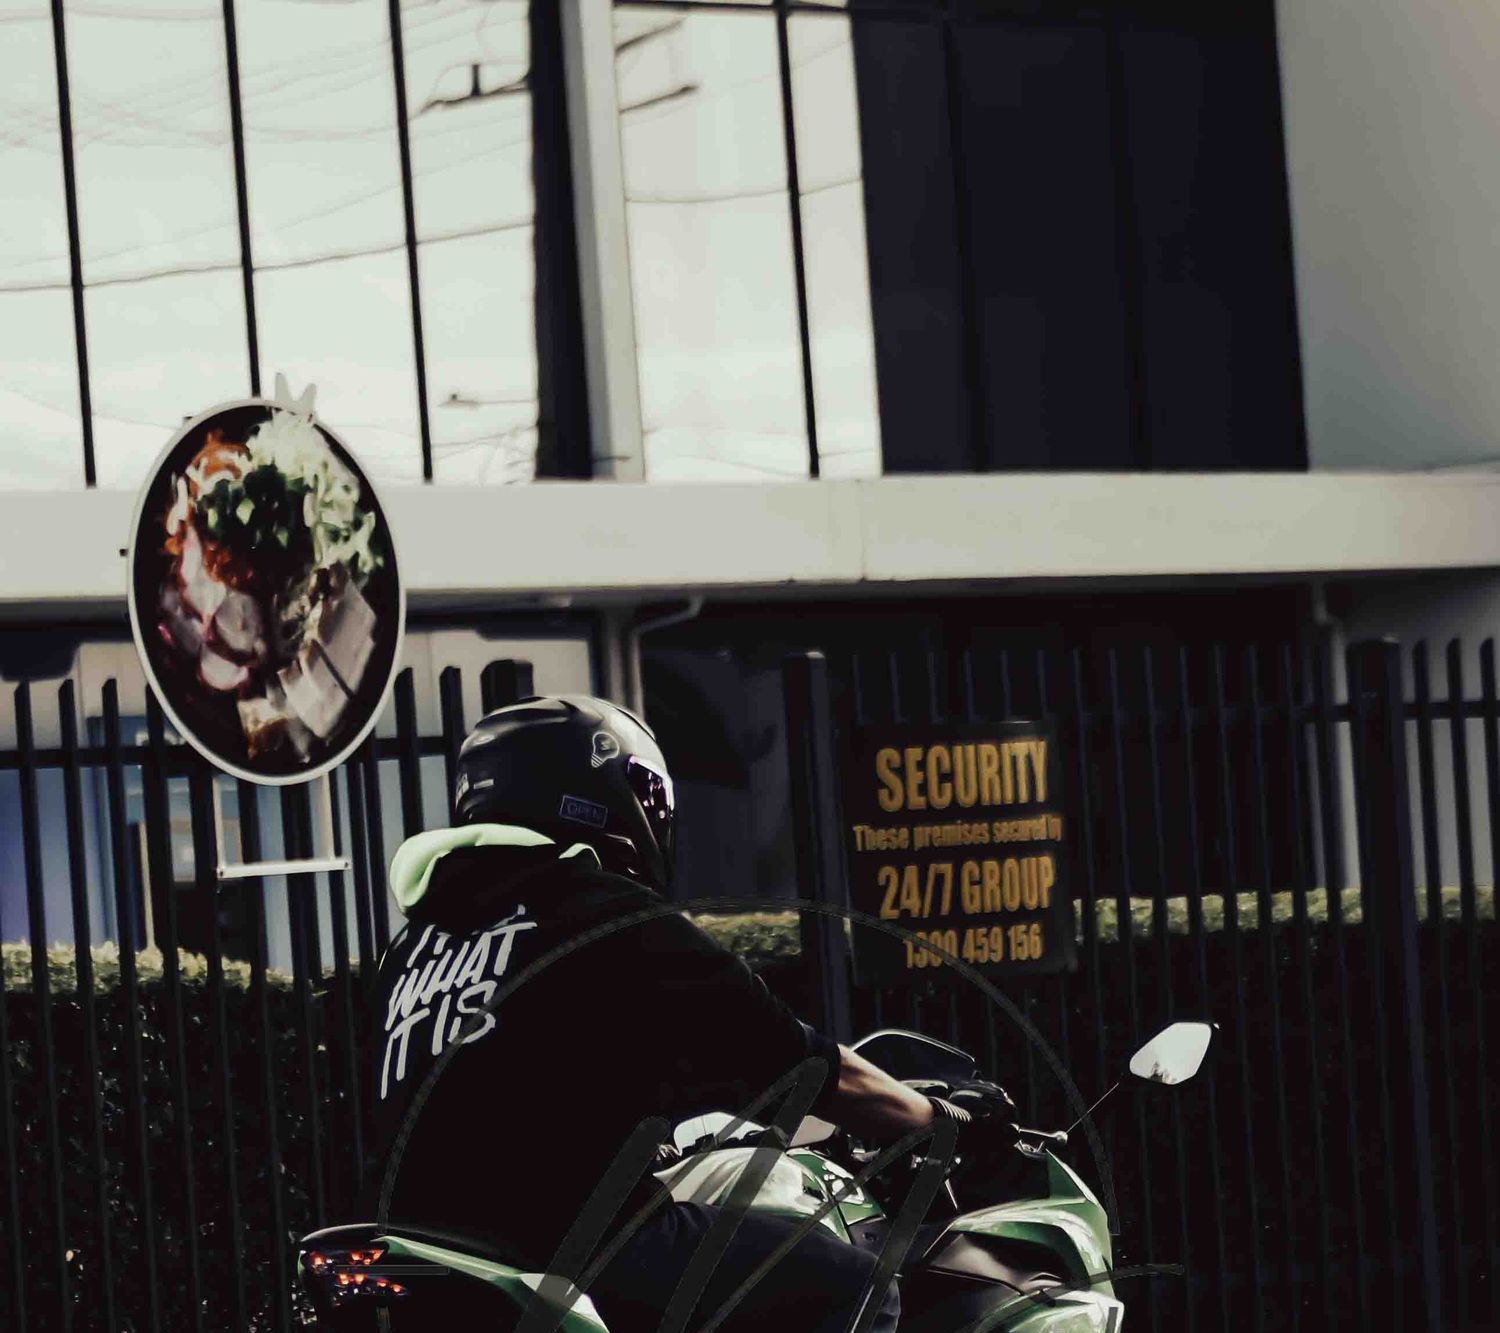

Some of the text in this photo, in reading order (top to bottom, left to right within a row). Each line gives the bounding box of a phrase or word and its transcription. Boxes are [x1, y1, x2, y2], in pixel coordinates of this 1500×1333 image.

[876, 739, 1048, 813] SECURITY
[852, 823, 910, 852] These
[913, 819, 991, 851] premises
[877, 855, 1056, 920] 24/7 GROUP
[384, 921, 539, 1032] WHAT
[962, 925, 1004, 964] 459
[1008, 921, 1044, 961] 156
[380, 979, 499, 1100] IT IS
